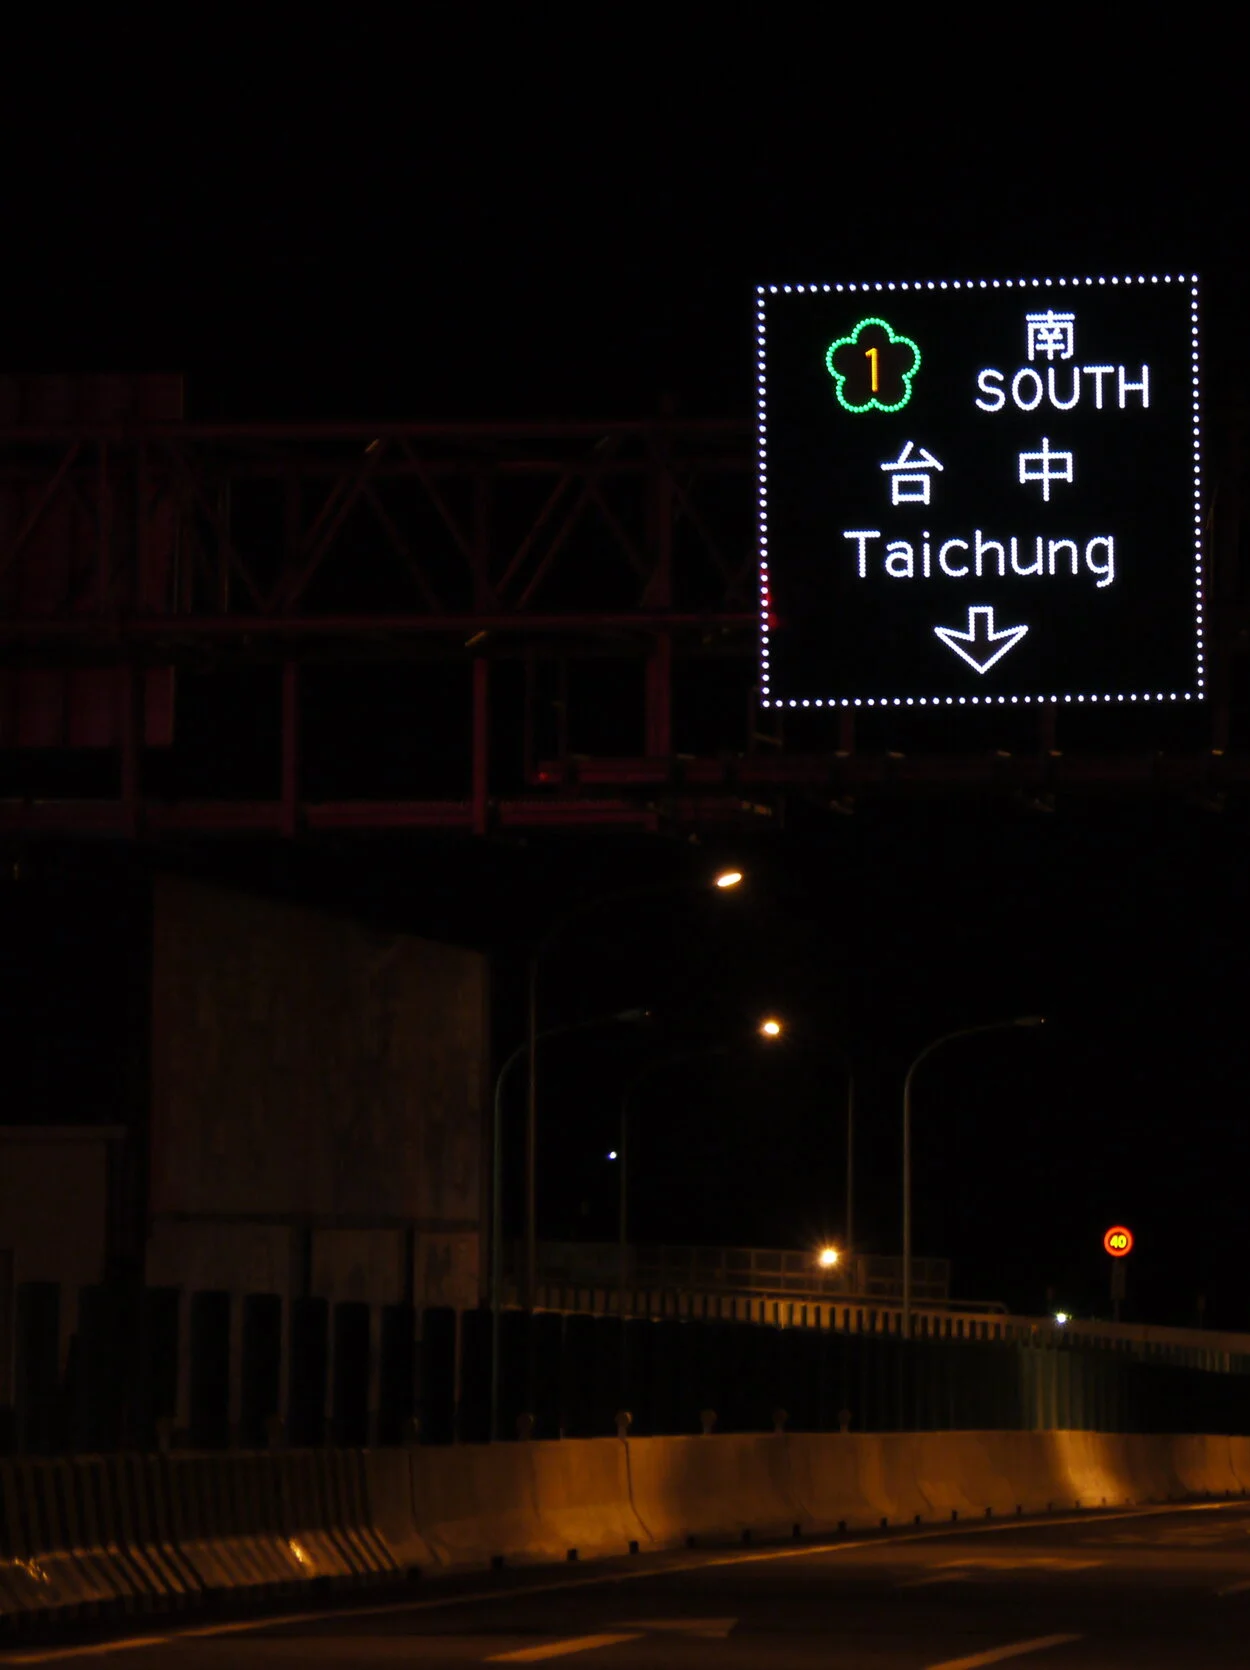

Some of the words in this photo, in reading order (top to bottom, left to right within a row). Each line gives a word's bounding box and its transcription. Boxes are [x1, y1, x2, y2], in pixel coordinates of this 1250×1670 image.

[1026, 309, 1075, 362] 南
[864, 347, 880, 393] 1
[974, 364, 1150, 413] SOUTH
[843, 529, 1115, 589] Taichung
[1110, 1235, 1127, 1249] 40
